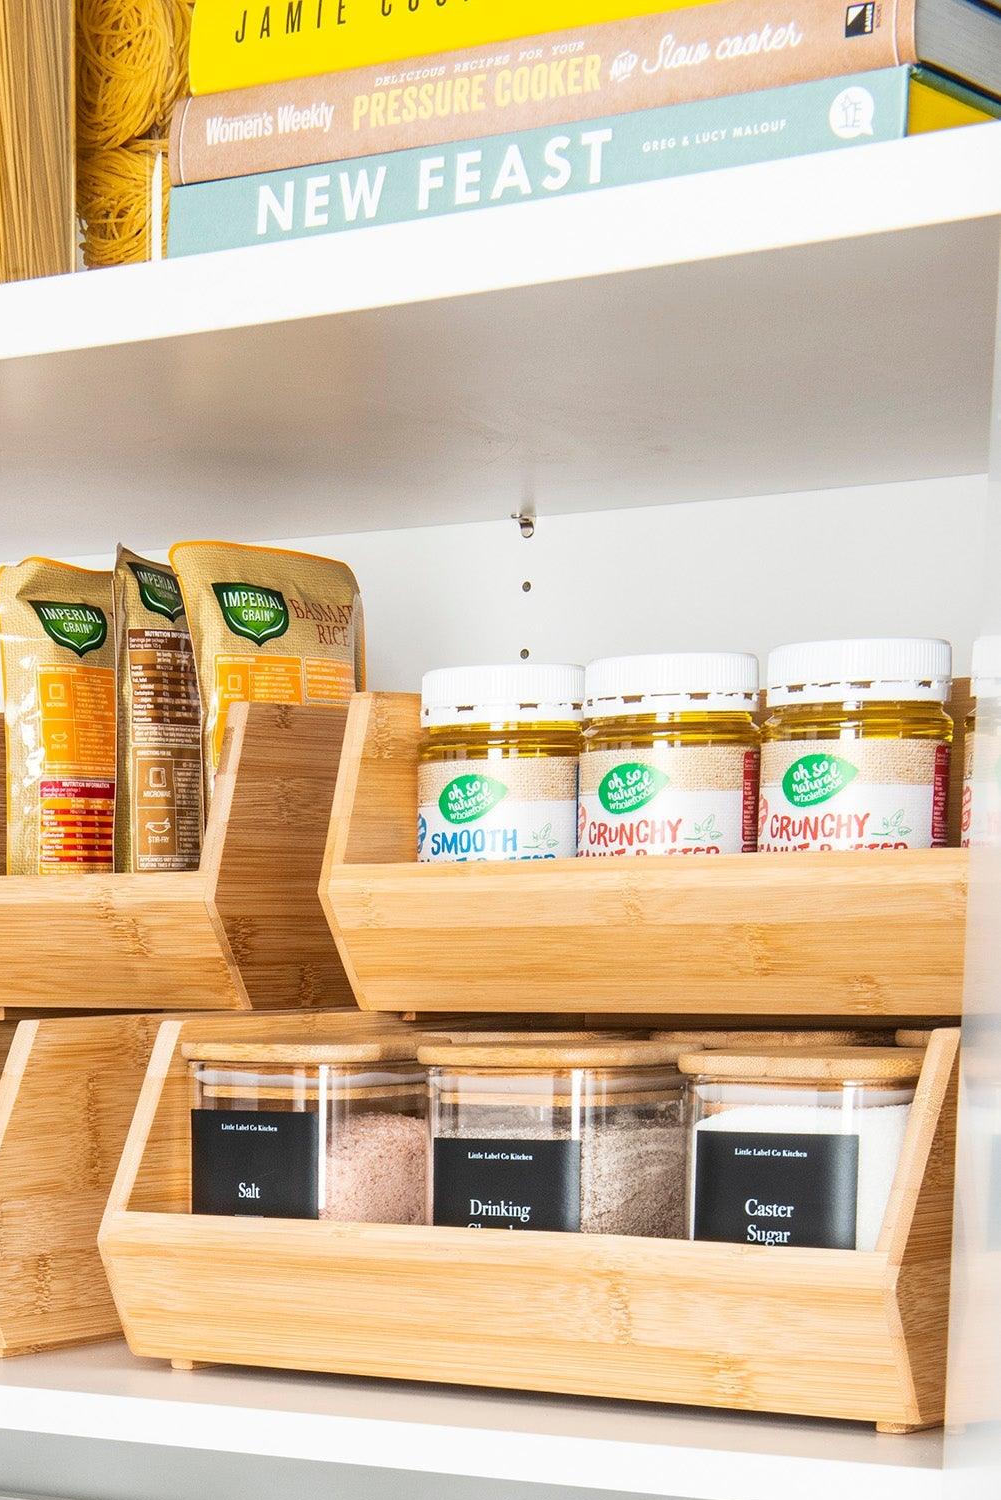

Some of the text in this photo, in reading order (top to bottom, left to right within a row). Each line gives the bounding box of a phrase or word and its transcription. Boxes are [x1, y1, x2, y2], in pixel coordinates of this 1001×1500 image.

[234, 0, 347, 43] JAMIE
[374, 40, 585, 87] DELICIOUS RECIPES FOR YOUR
[610, 21, 803, 81] AND Slow cooker
[352, 53, 601, 131] PRESSURE COOKER
[206, 101, 334, 145] Women's Weekly
[642, 119, 787, 153] GREG & LUCY MALOUF
[256, 128, 613, 235] NEW FEAST
[222, 591, 283, 611] IMPERIAL
[290, 599, 353, 624] BASMAT
[40, 607, 102, 624] IMPERIAL
[317, 624, 351, 646] RICE
[607, 769, 640, 790] oh so
[792, 760, 828, 781] oh so
[792, 762, 841, 794] natural
[448, 780, 481, 801] oh so
[607, 770, 654, 801] natural
[588, 818, 683, 848] CRUNCHY
[770, 812, 871, 842] CRUNCHY
[431, 828, 517, 855] SMOOTH
[467, 1151, 533, 1161] Little Label Co Kitchen
[734, 1147, 808, 1158] Little Label Co Kitchen
[238, 1182, 261, 1199] Salt
[469, 1199, 531, 1222] Drinking
[745, 1198, 795, 1217] Caster
[746, 1224, 791, 1247] Sugar
